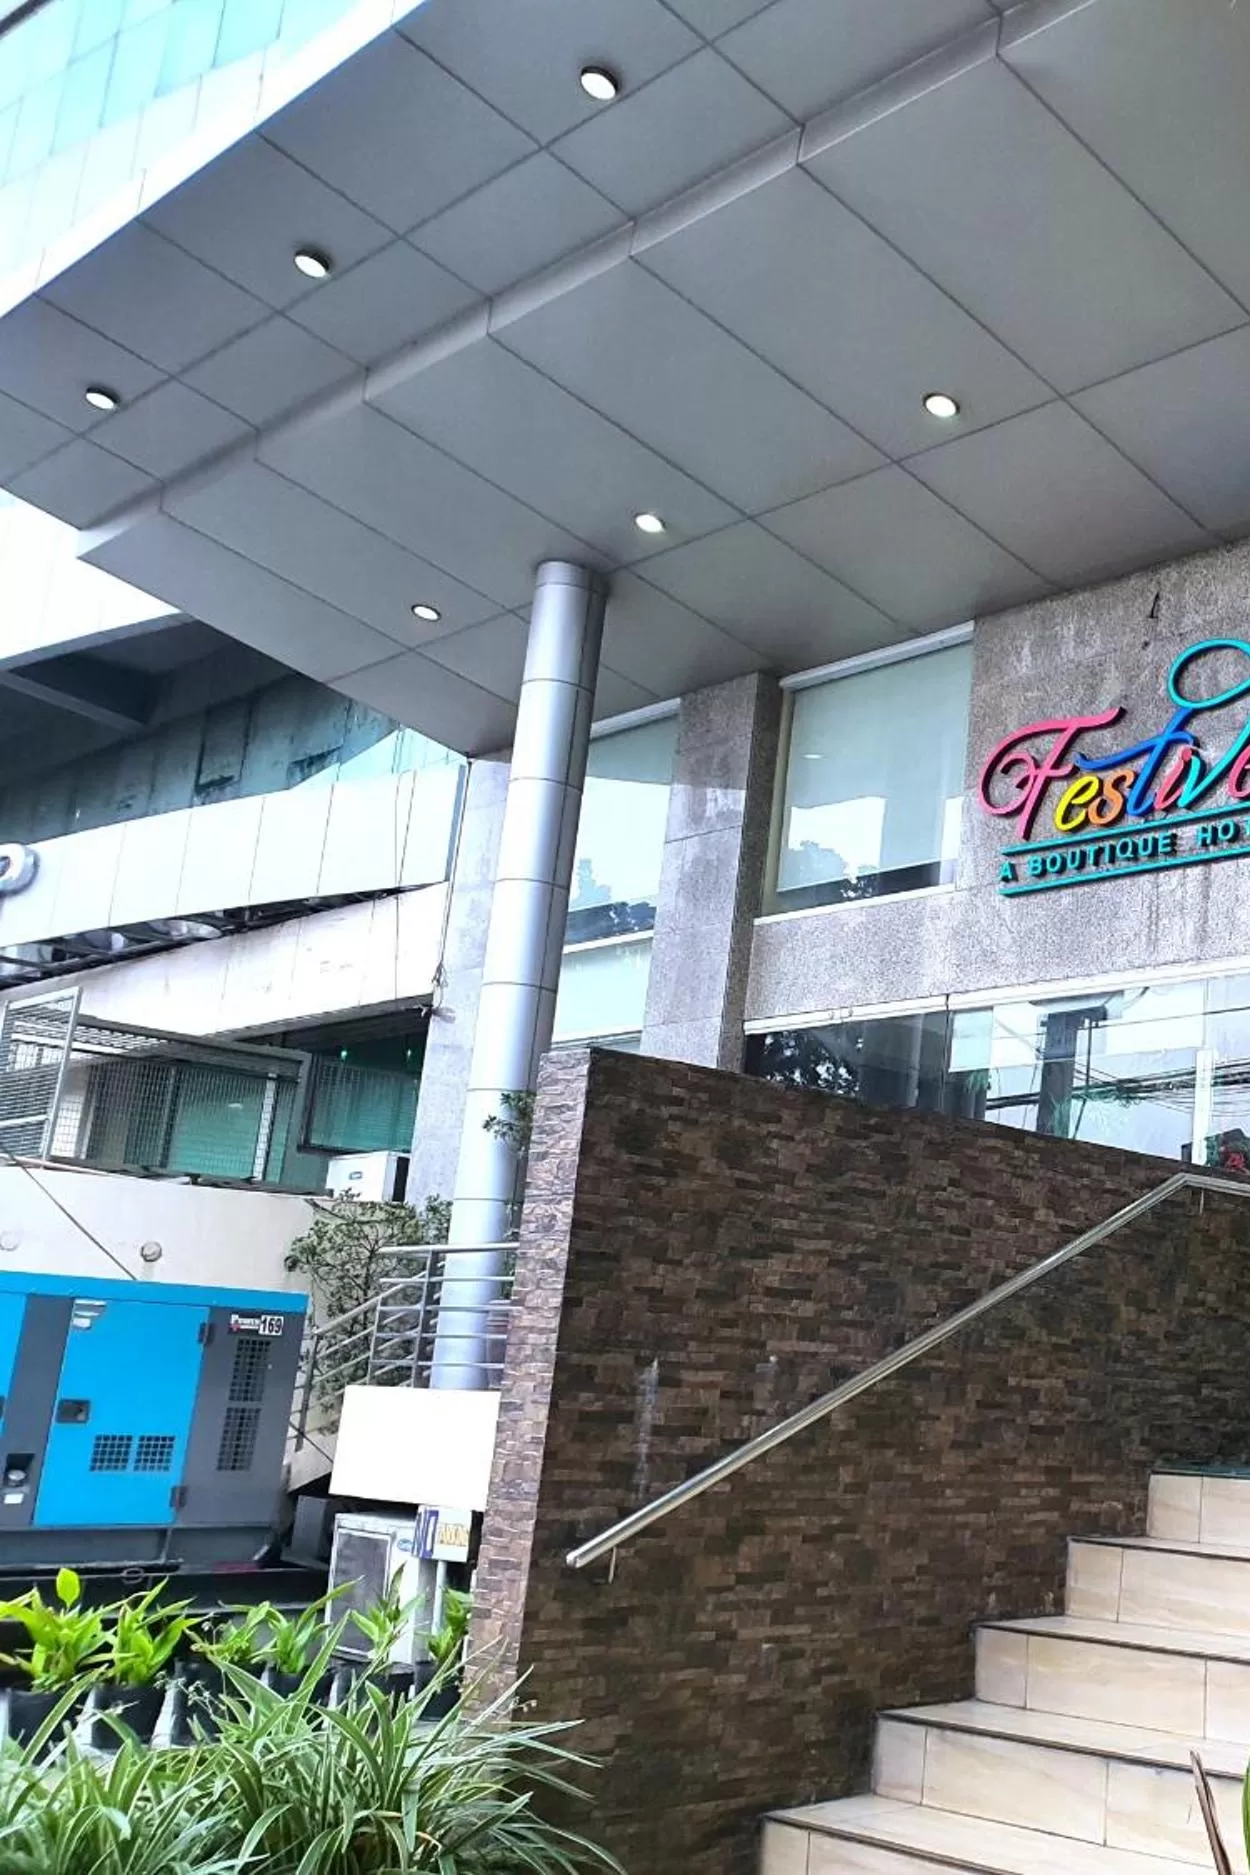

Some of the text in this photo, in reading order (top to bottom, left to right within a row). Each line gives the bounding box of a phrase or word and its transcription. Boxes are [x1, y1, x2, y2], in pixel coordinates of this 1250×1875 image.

[1000, 861, 1016, 880] A
[1028, 834, 1174, 878] BOUTIQUE
[261, 1316, 283, 1334] 169
